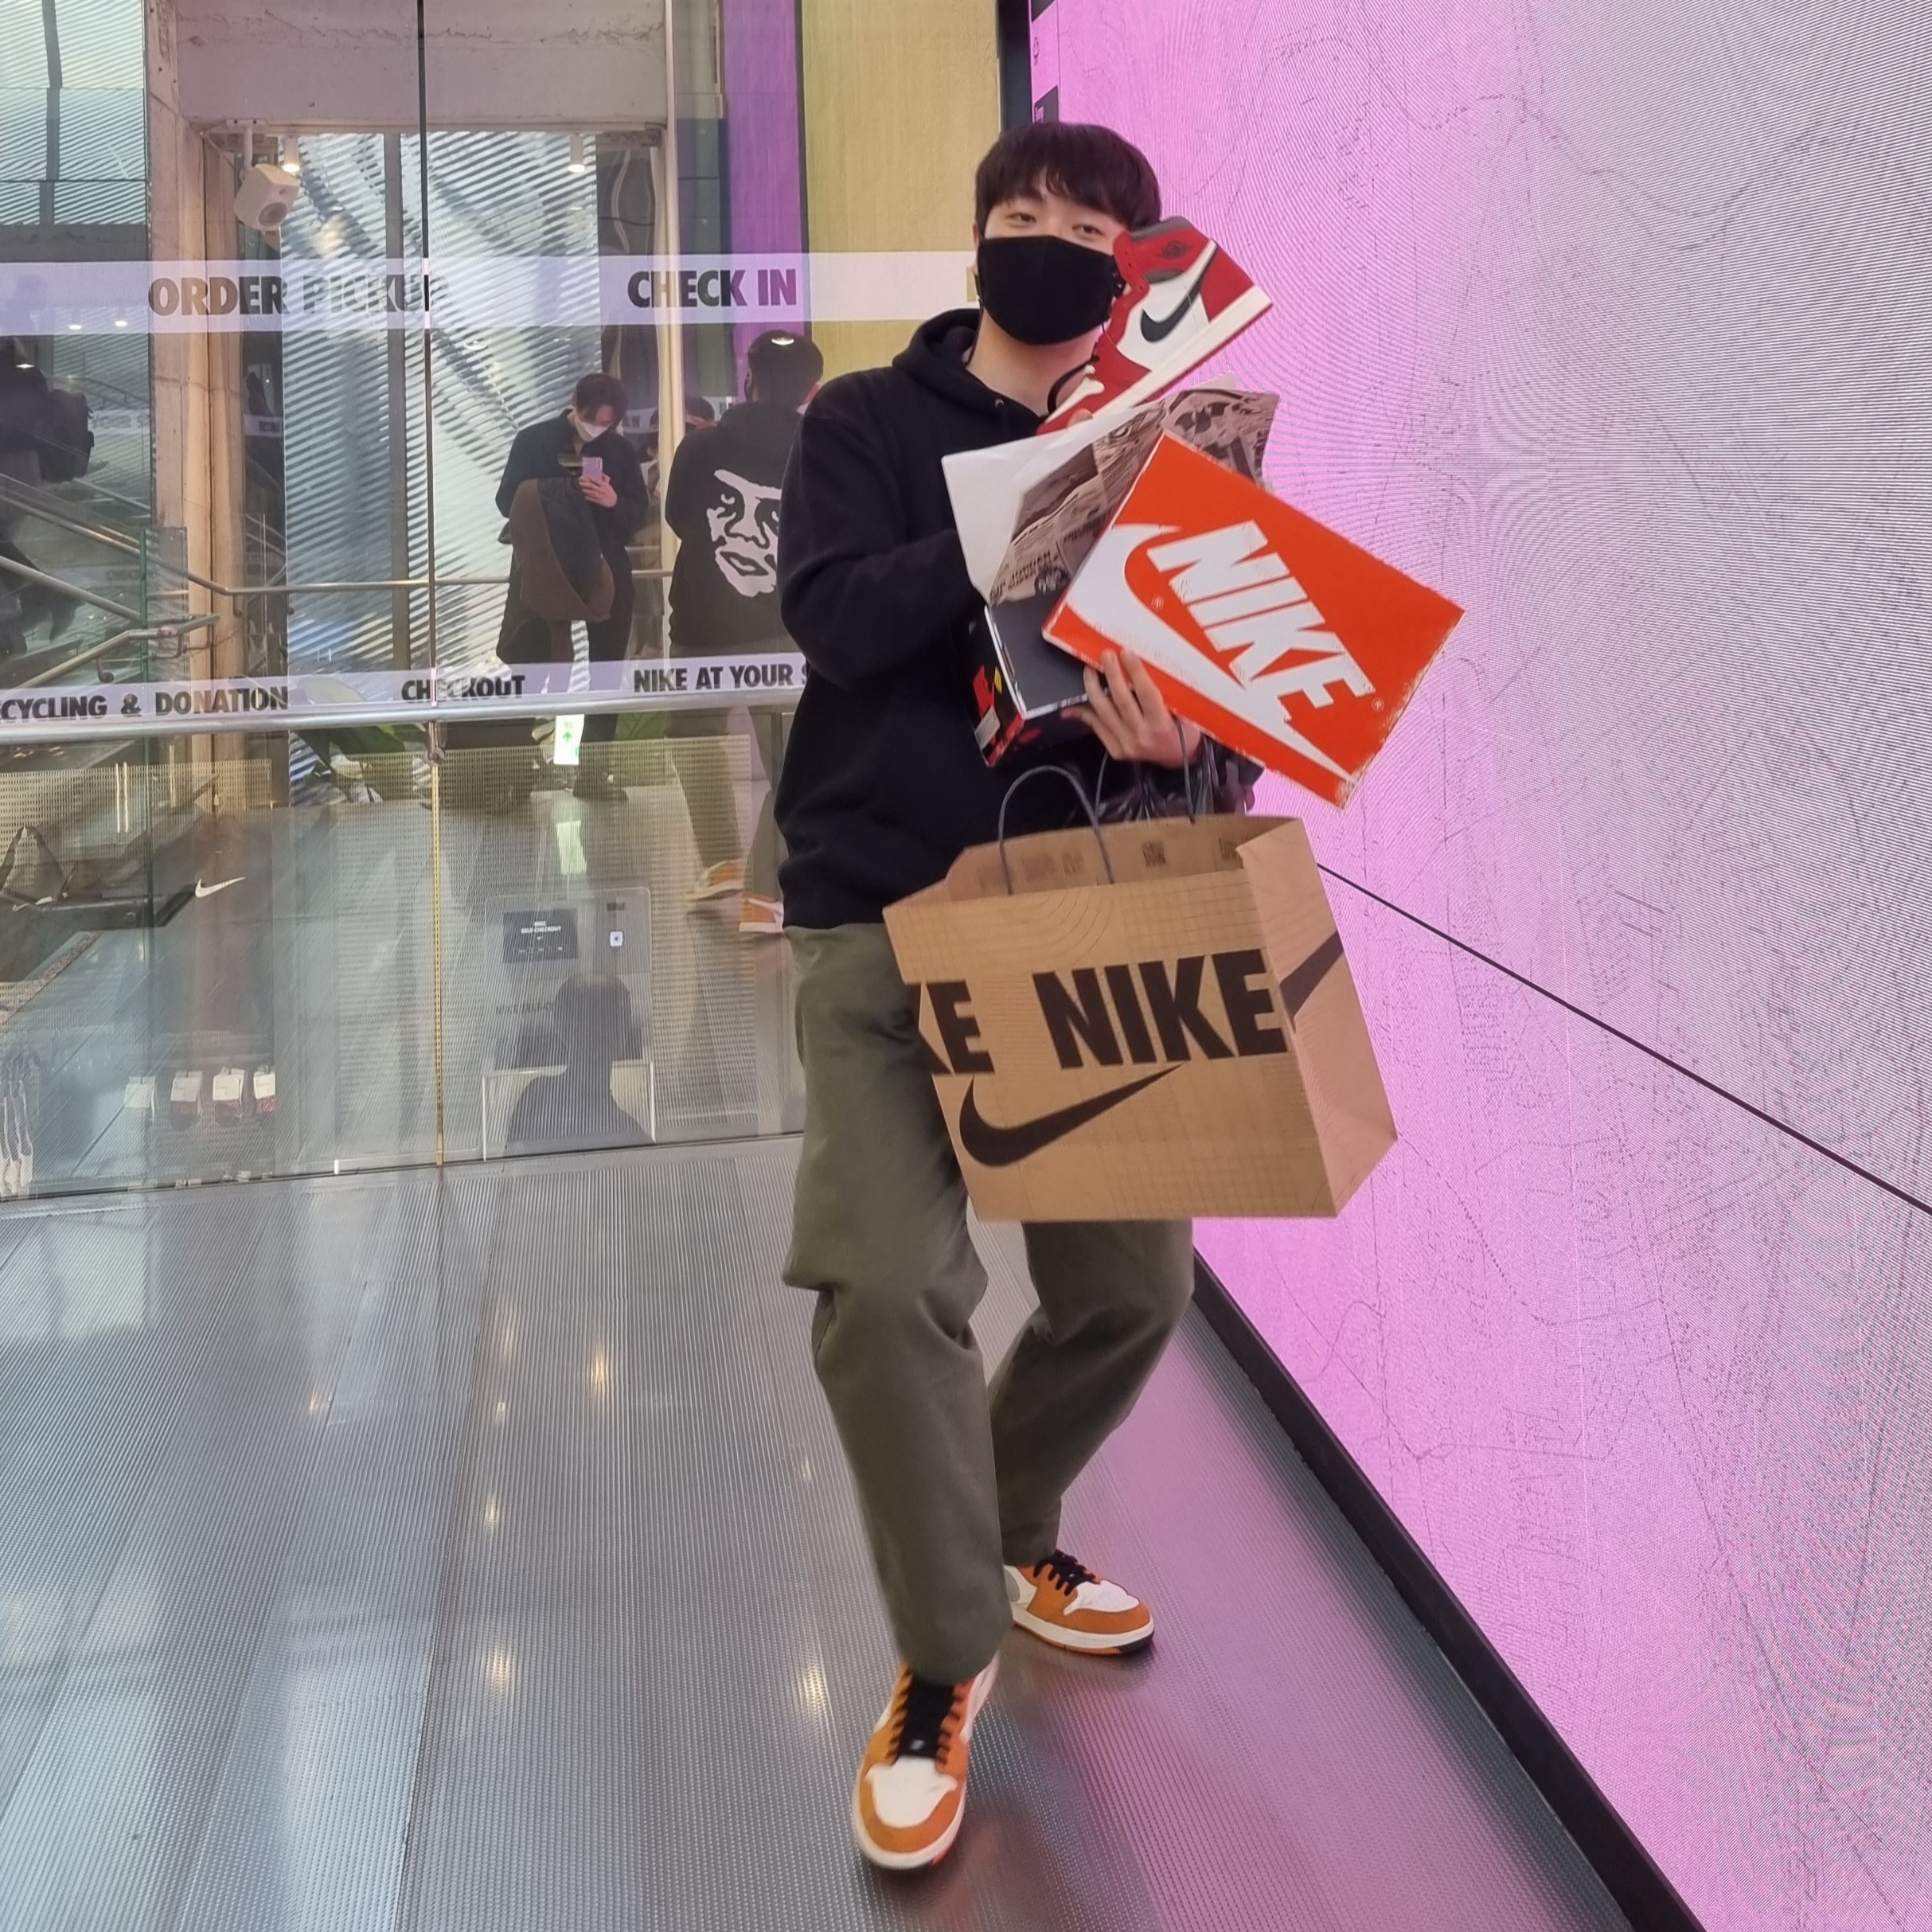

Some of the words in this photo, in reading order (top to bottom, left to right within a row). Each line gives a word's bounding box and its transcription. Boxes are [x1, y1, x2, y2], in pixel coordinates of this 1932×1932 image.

[148, 275, 290, 316] ORDER
[627, 270, 747, 308] CHECK
[757, 269, 797, 306] IN
[1146, 519, 1376, 723] NIKE
[634, 667, 688, 693] NIKE
[696, 665, 724, 689] AT
[729, 663, 794, 688] YOUR
[0, 696, 107, 720] CYCLING
[121, 693, 142, 716] &
[156, 686, 288, 715] DONATION
[1032, 948, 1288, 1070] NIKE
